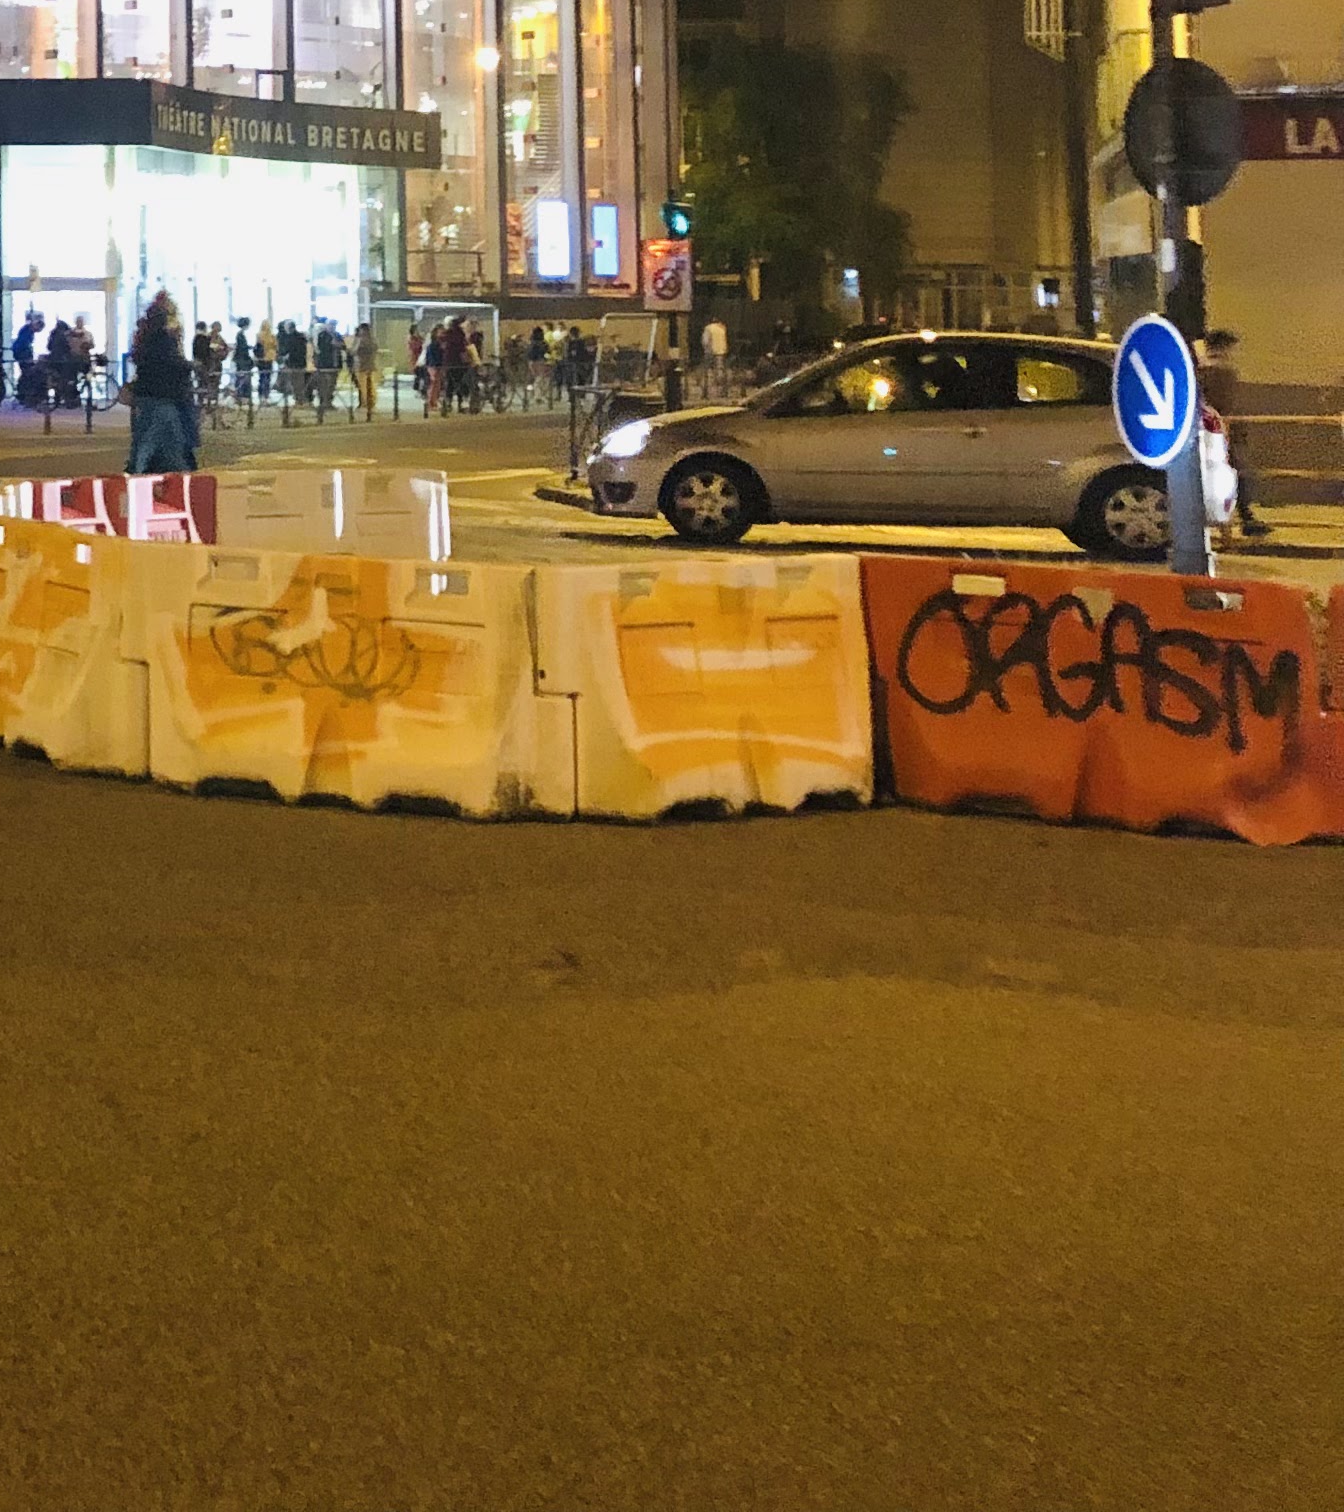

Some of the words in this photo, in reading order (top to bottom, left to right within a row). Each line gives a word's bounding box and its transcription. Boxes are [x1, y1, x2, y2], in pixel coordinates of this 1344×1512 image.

[211, 114, 297, 146] NATIONAL
[307, 124, 427, 153] BRETAGNE
[896, 589, 1302, 763] ORGASM
